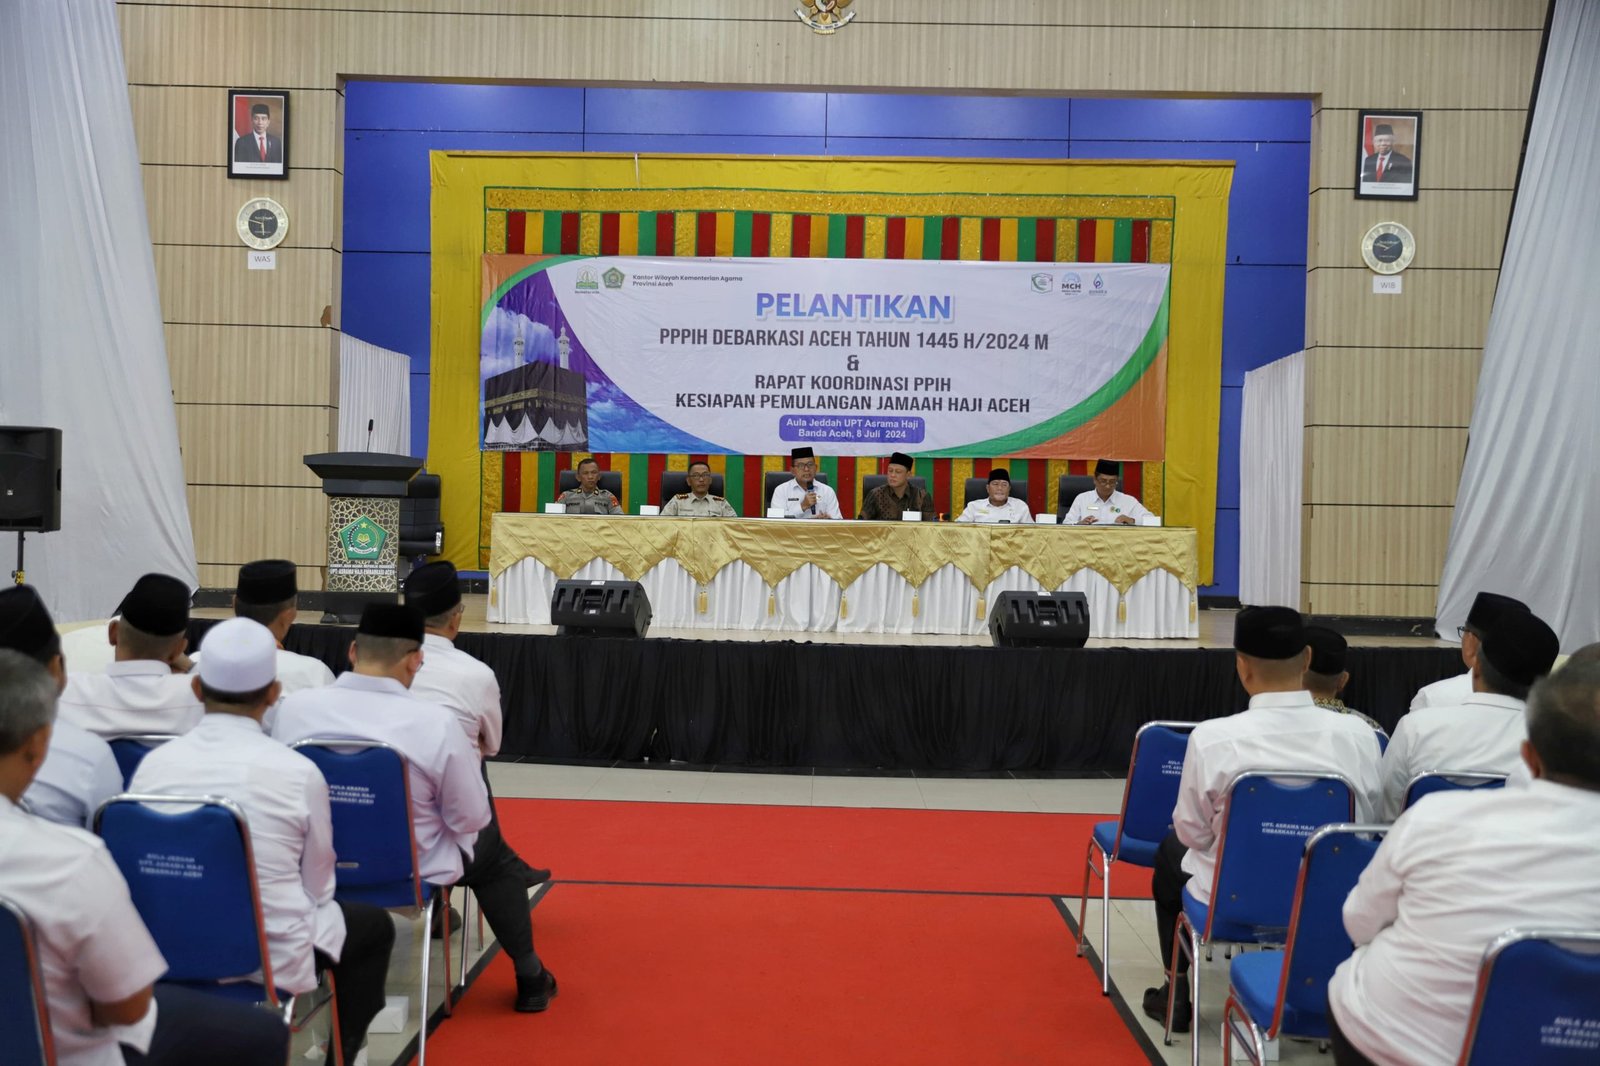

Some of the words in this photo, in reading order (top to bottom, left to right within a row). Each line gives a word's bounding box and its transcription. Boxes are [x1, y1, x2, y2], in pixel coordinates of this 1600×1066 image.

[654, 275, 680, 283] Wilayah
[756, 292, 951, 319] PELANTIKAN
[660, 328, 708, 345] PPPIH
[713, 329, 804, 346] DEBARKASI
[809, 330, 852, 347] ACEH
[856, 331, 910, 348] TAHUN
[916, 332, 959, 349] 1445
[963, 333, 1030, 350] H/2024
[1034, 334, 1049, 350] M
[847, 354, 860, 371] &
[755, 375, 806, 389] RAPAT
[811, 375, 909, 391] KOORDINASI
[913, 377, 951, 392] PPIH
[675, 393, 755, 408] KESIAPAN
[760, 394, 872, 410] PEMULANGAN
[876, 396, 943, 411] JAMAAH
[948, 397, 983, 412] HAJI
[987, 398, 1030, 413] ACEH
[786, 418, 807, 427] Aula
[809, 418, 842, 427] Jeddah
[844, 419, 863, 427] UPT
[864, 420, 899, 429] Asrama
[901, 420, 919, 430] Haji
[798, 428, 827, 437] Banda
[829, 429, 854, 439] Aceh,
[856, 430, 862, 438] 8
[864, 430, 881, 438] Juli
[885, 430, 906, 438] 2024
